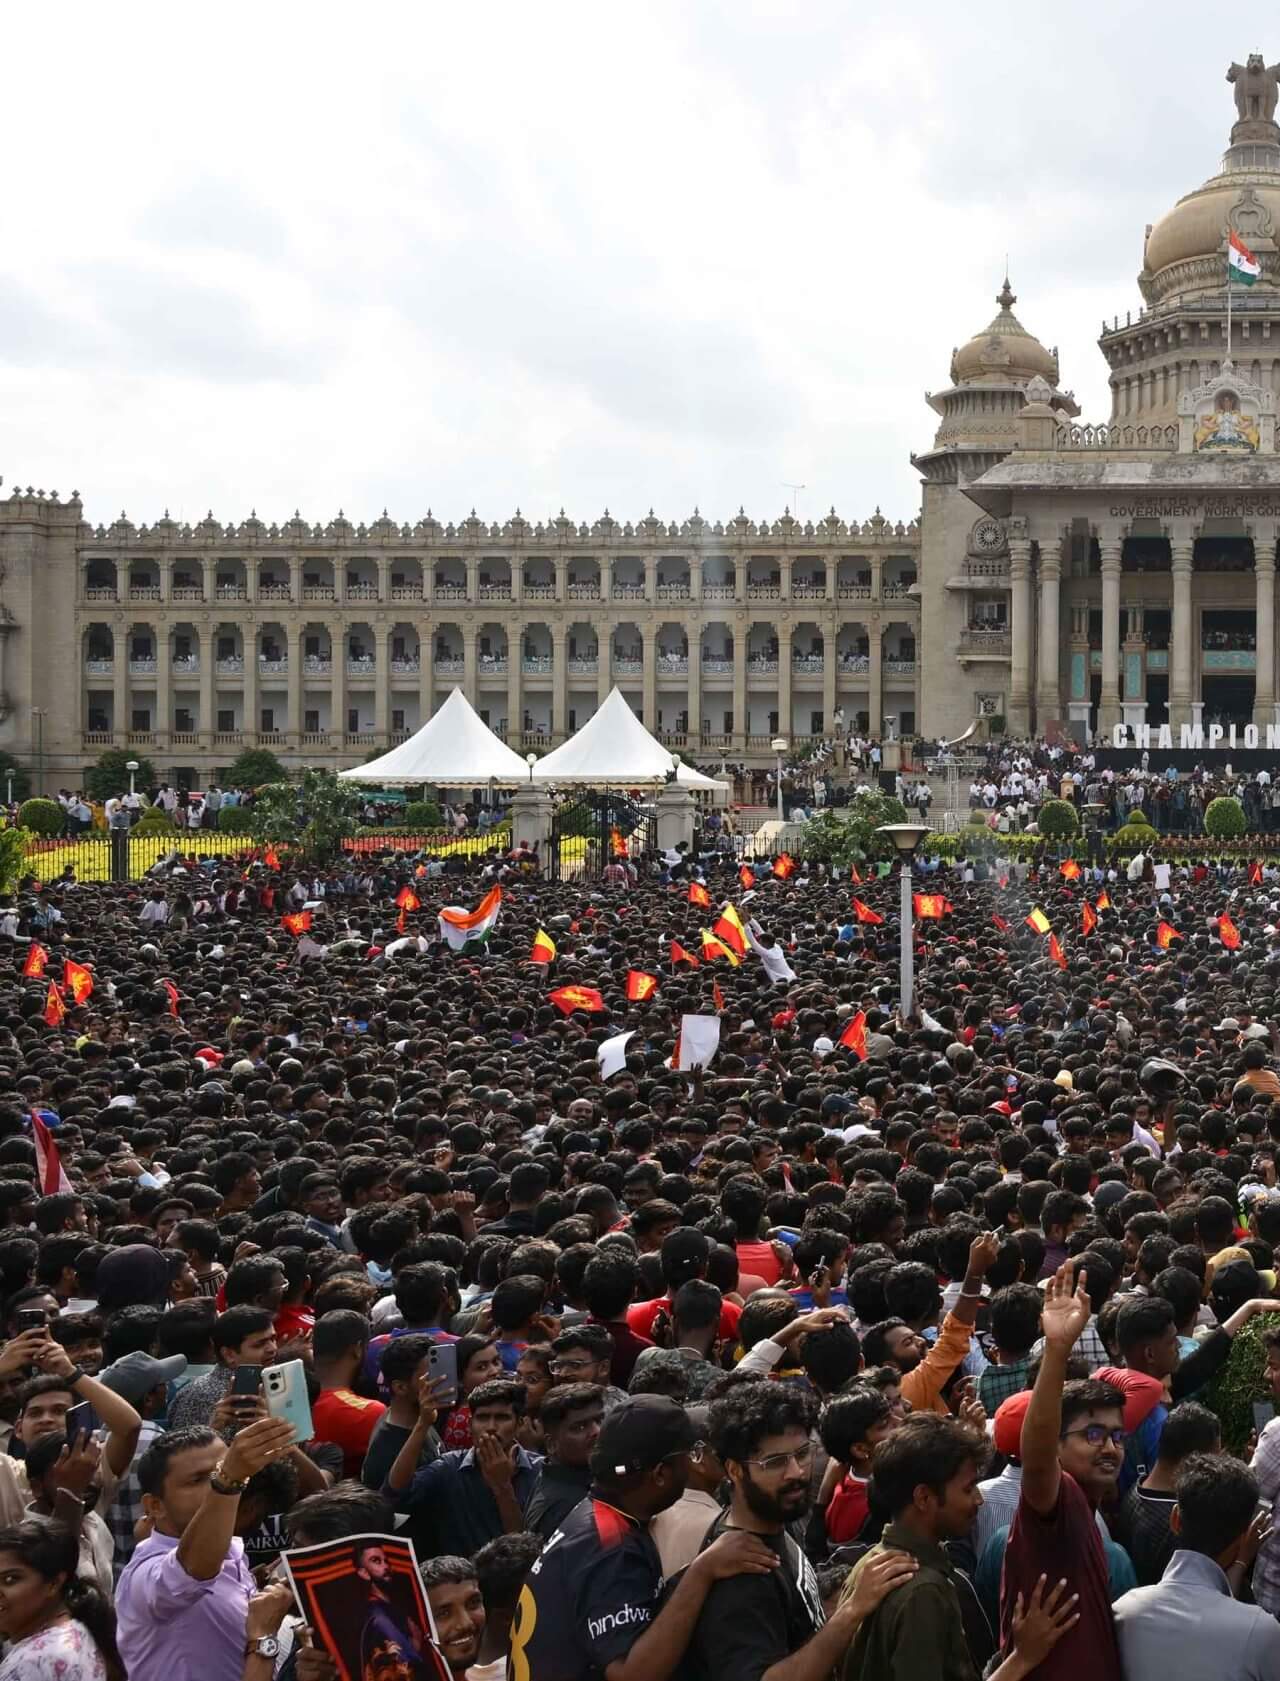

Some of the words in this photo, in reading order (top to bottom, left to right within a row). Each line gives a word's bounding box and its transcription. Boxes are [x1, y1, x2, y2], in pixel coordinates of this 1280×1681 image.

[1111, 505, 1197, 517] GOVERNMENT
[1205, 505, 1239, 517] WORK
[1242, 505, 1254, 517] IS
[245, 1536, 289, 1550] AIRW
